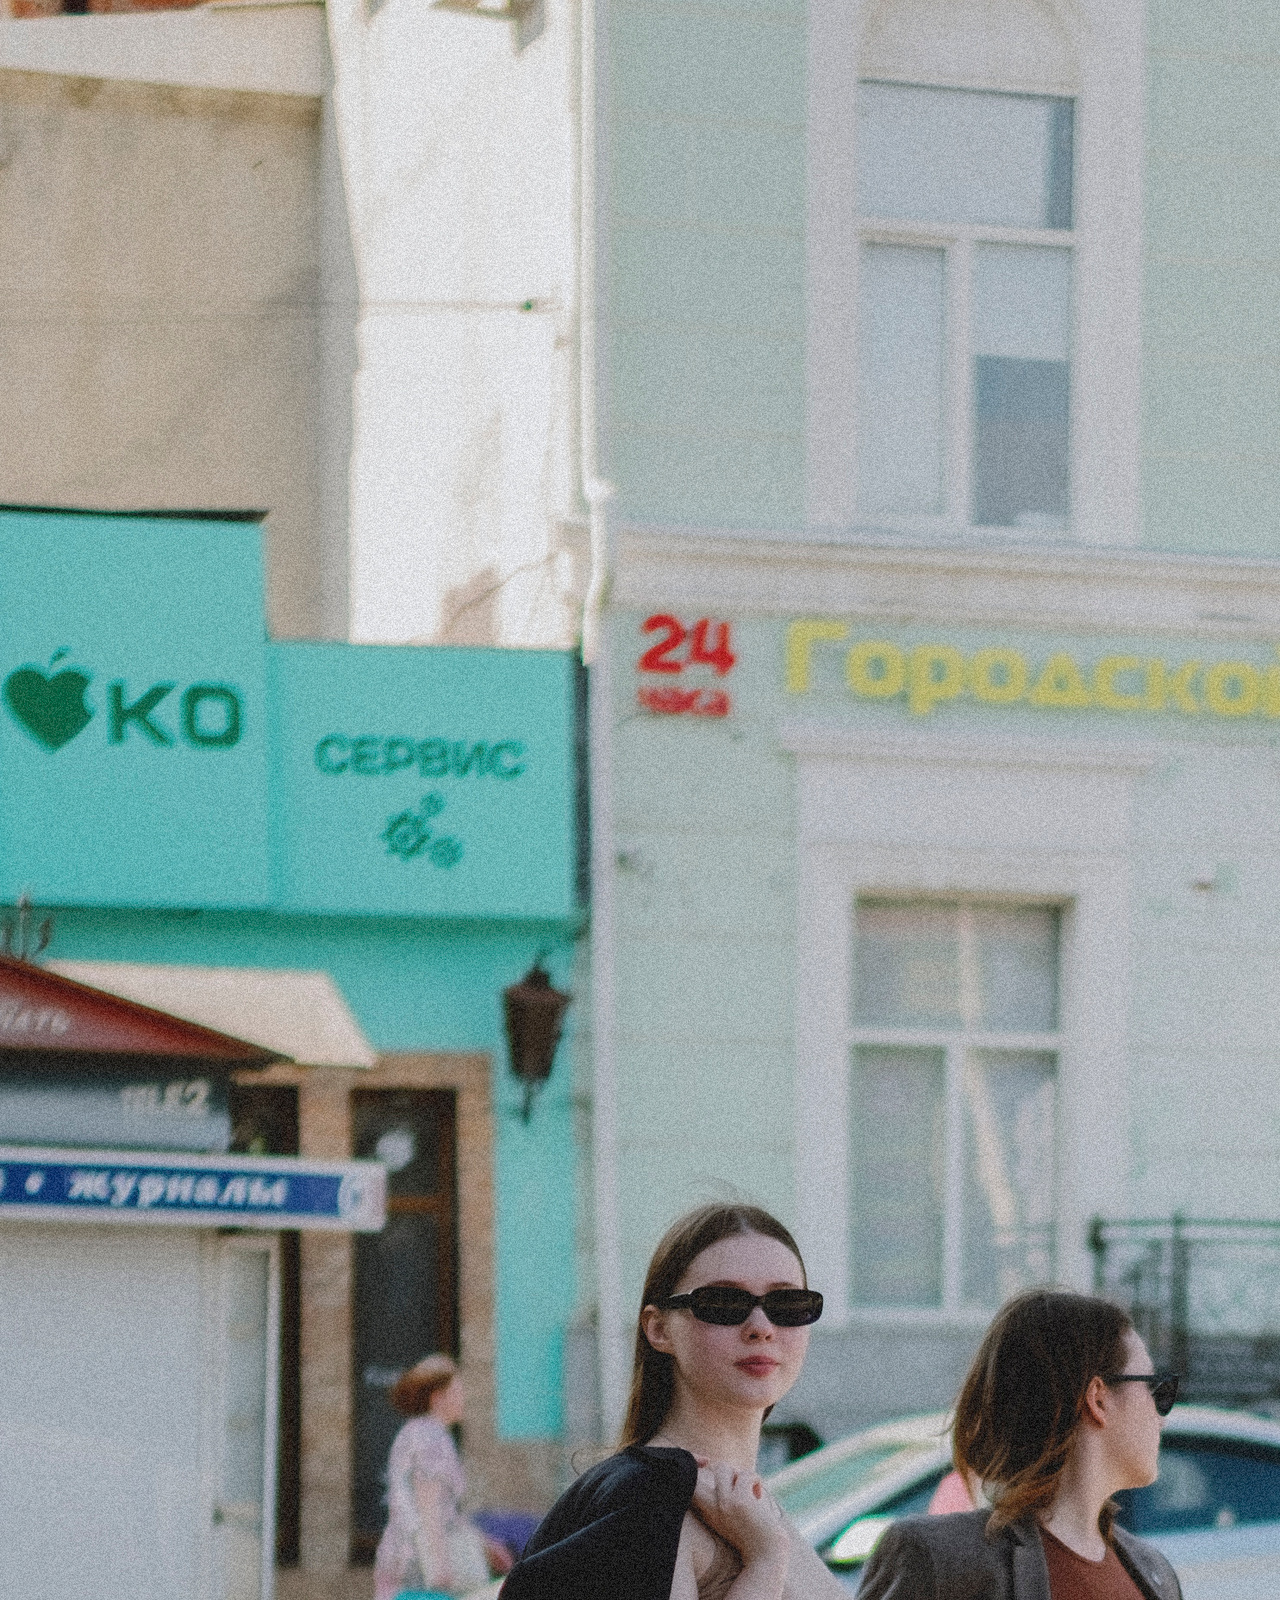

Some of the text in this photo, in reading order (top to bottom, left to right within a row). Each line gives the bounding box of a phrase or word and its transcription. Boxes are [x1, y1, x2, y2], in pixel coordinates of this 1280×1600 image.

[638, 614, 737, 677] 24
[314, 735, 523, 779] СЕРВИС
[69, 1170, 288, 1208] журналы
